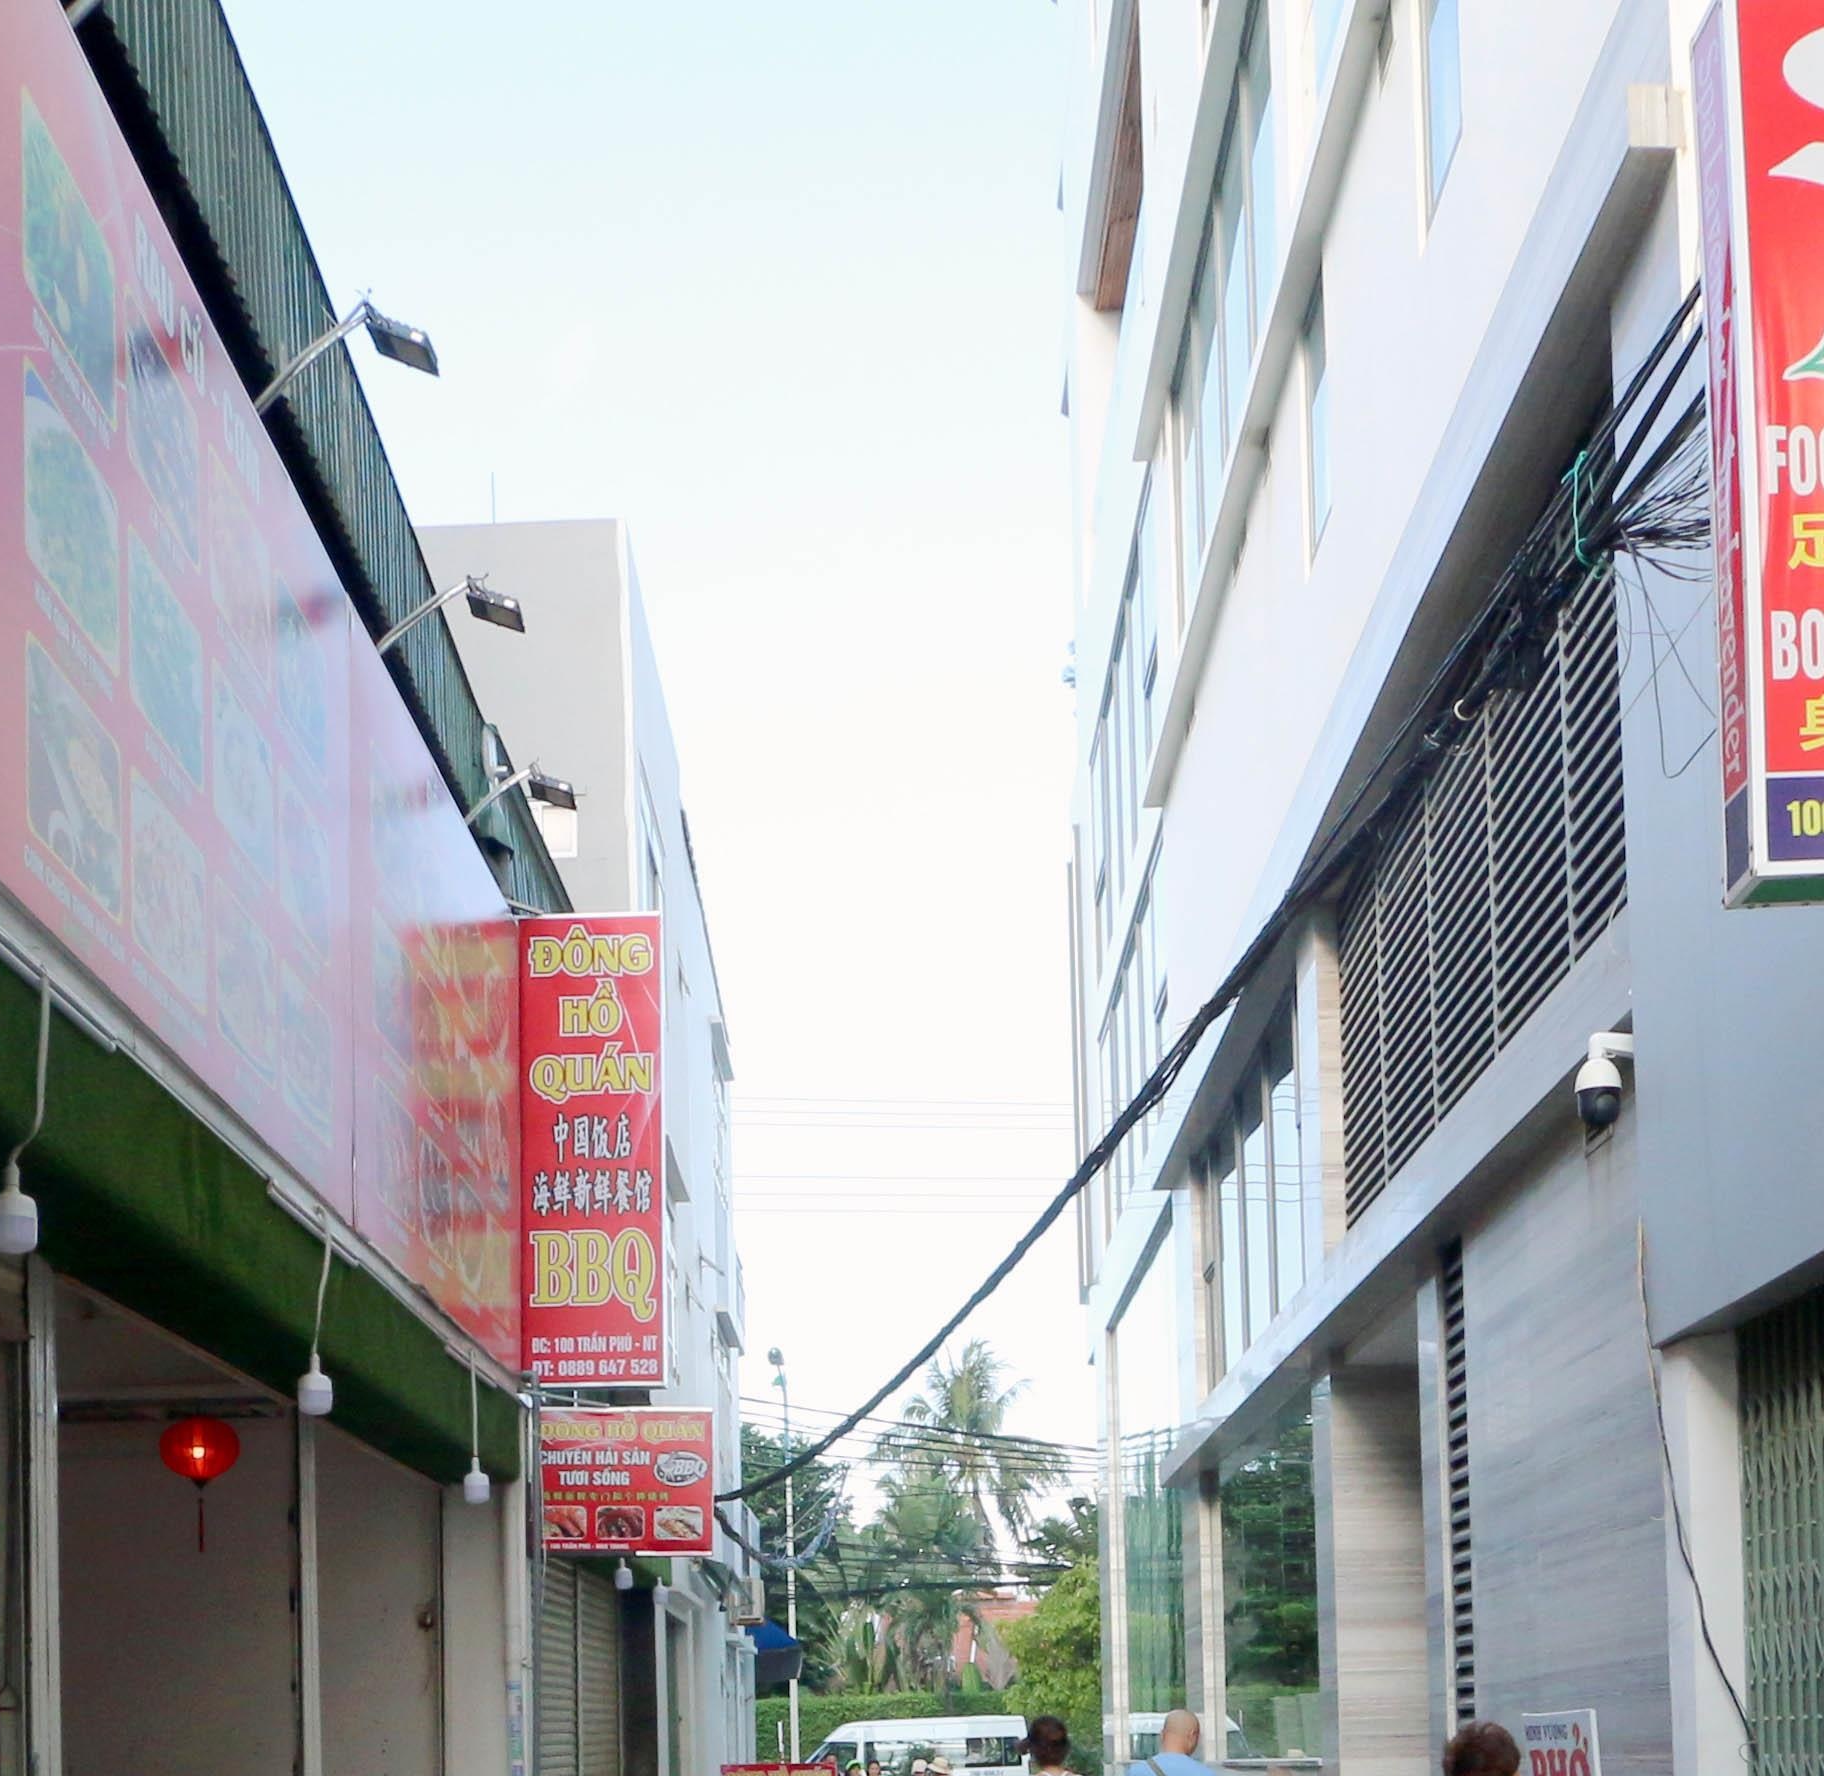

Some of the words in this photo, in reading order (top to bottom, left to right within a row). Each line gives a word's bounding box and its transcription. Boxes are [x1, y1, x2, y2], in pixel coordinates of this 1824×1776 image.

[135, 210, 175, 338] RAU
[529, 924, 653, 977] ĐÔNG
[559, 978, 622, 1037] HỒ
[530, 1042, 654, 1104] QUÁN
[552, 1114, 632, 1162] 中国饭店
[532, 1169, 653, 1217] 海鲜新鲜餐馆
[529, 1228, 657, 1323] BBQ
[554, 1336, 575, 1354] 100
[599, 1360, 625, 1376] 647
[630, 1358, 658, 1375] 528
